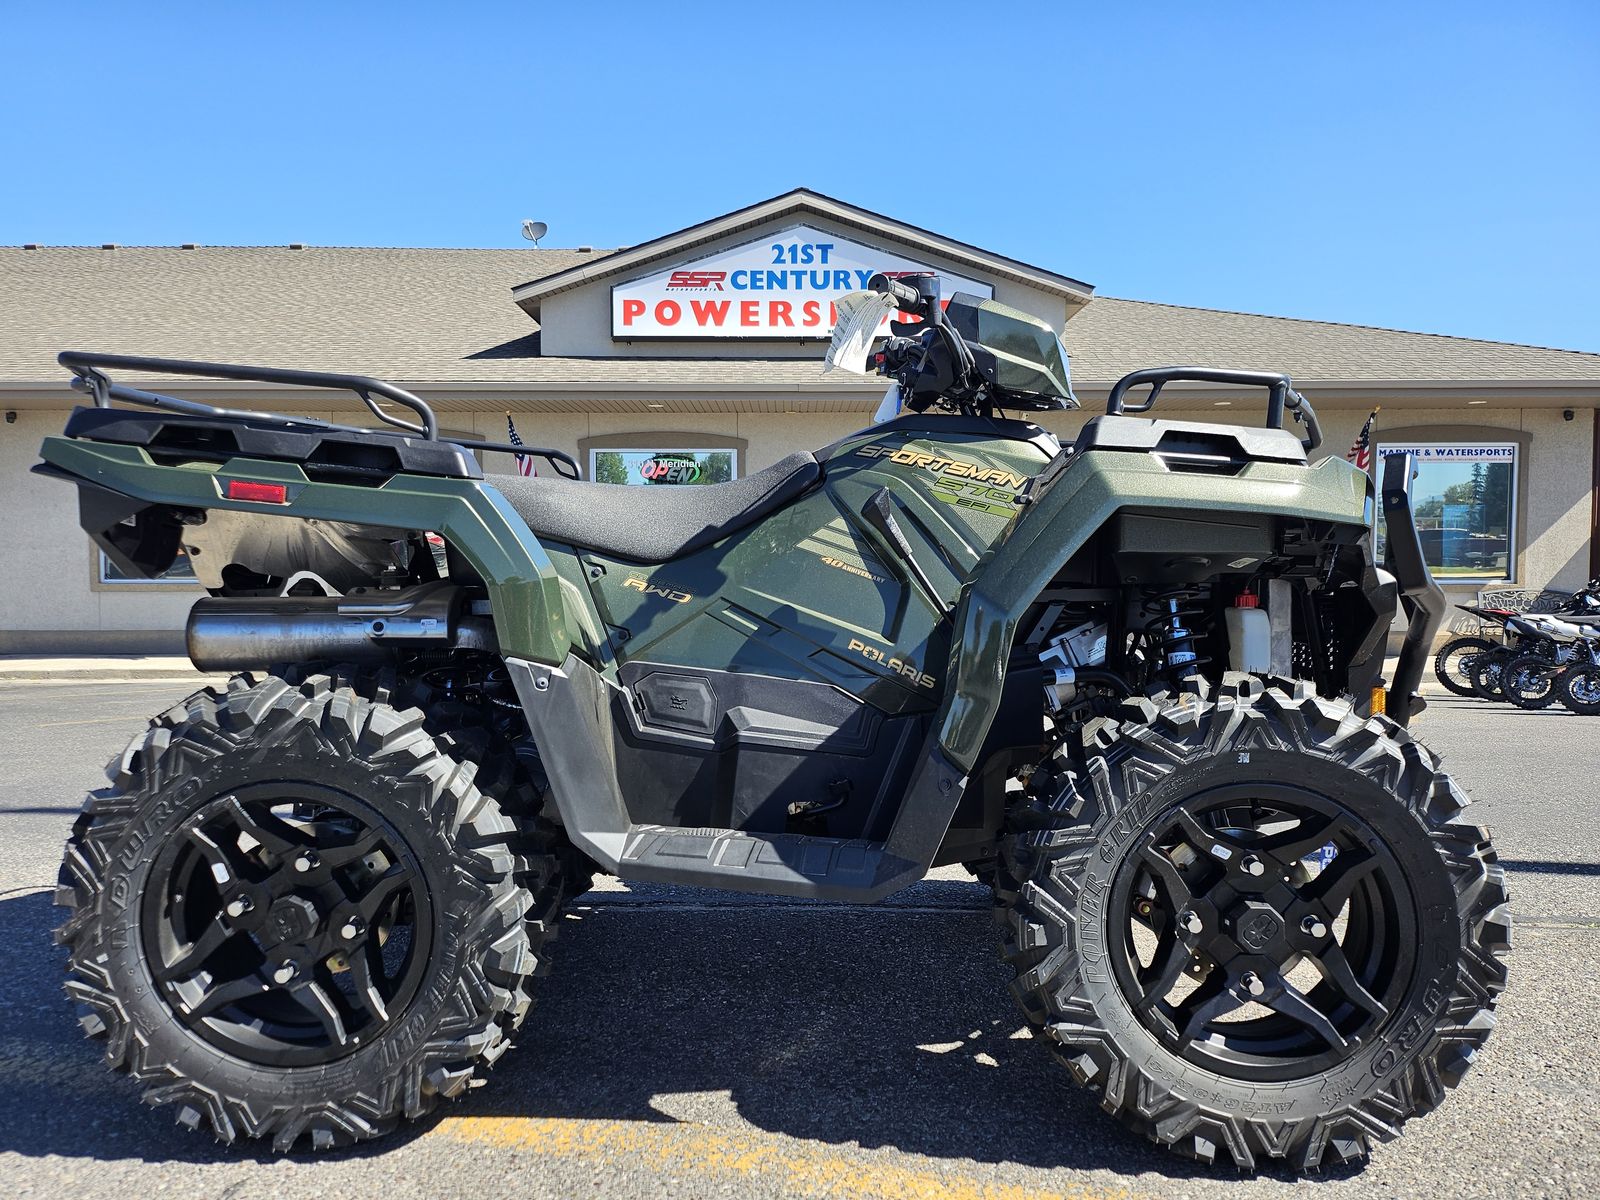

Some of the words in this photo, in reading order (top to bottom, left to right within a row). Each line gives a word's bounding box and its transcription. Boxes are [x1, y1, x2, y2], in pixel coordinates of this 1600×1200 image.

[771, 243, 834, 265] 21ST
[667, 271, 727, 291] SSR
[730, 270, 873, 291] CENTURY
[660, 459, 700, 468] Meridian
[1424, 448, 1431, 456] &
[1435, 448, 1513, 457] WATERSPORTS
[641, 461, 694, 482] OPEN
[856, 445, 1028, 489] SPORTSMAN
[934, 476, 1016, 504] 570
[955, 498, 990, 512] EFI
[821, 556, 844, 568] 40
[841, 564, 886, 583] ANNIVERSARY
[622, 578, 693, 603] AWD
[847, 638, 936, 689] POLARIS
[110, 776, 203, 911] DURO
[1080, 872, 1108, 984] POWER
[1100, 792, 1152, 864] GRIP
